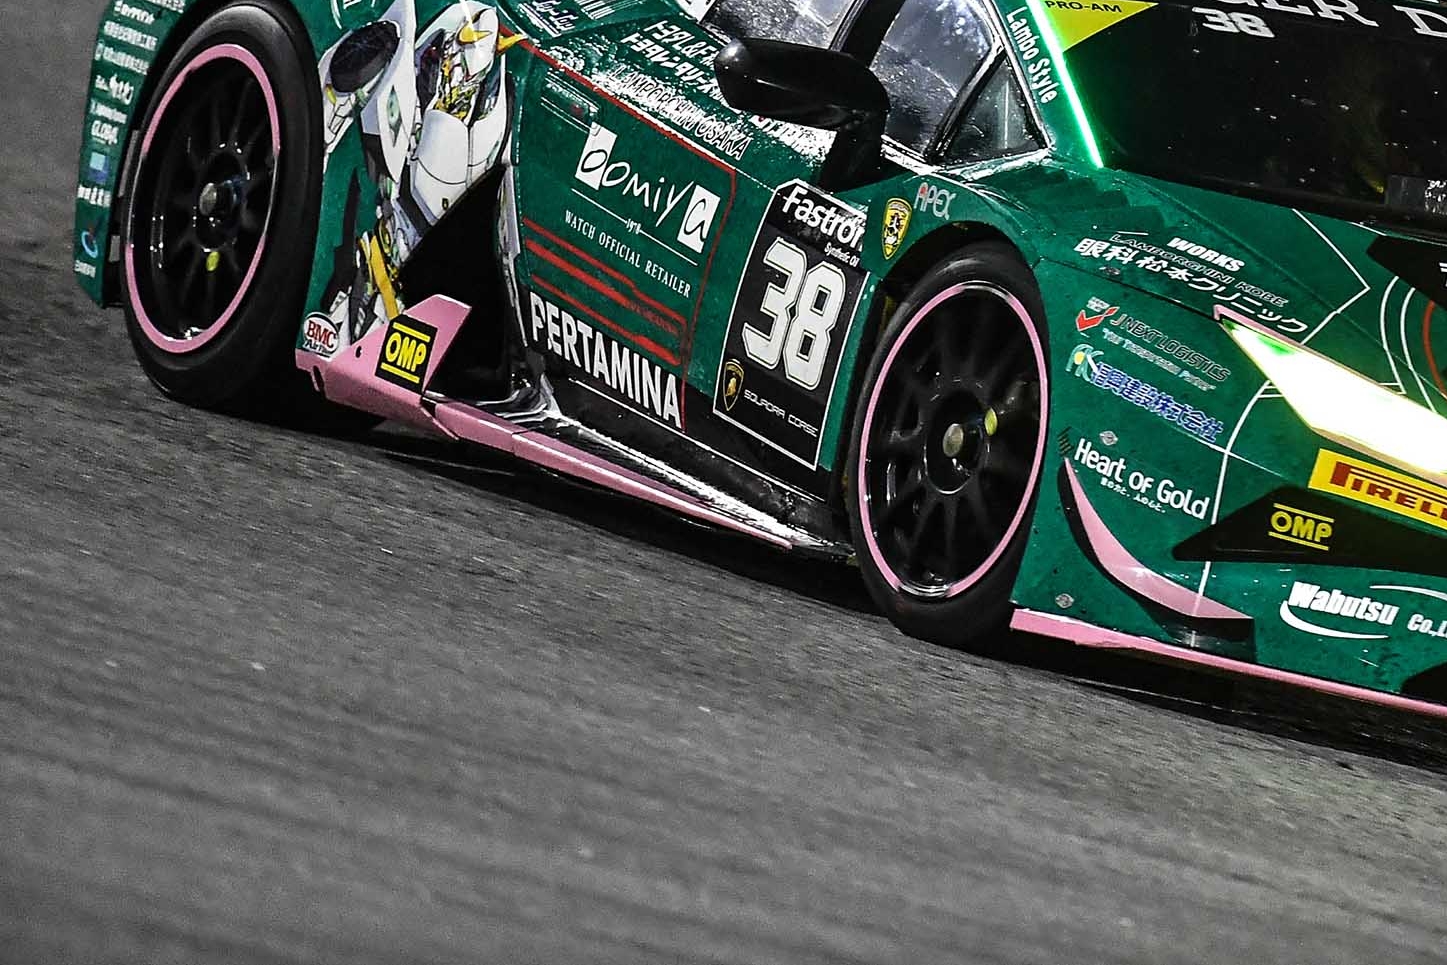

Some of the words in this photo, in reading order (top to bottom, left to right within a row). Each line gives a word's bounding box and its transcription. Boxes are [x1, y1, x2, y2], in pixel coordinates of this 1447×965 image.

[1045, 0, 1122, 14] PRO-AM
[1191, 6, 1276, 39] 38
[1006, 6, 1040, 61] Lambo
[1028, 57, 1061, 105] Style
[564, 209, 597, 240] WATCH
[598, 231, 642, 269] OFFICIAL
[644, 260, 692, 299] RETAILER
[1109, 233, 1236, 285] LAMBORGHINI
[1234, 281, 1290, 308] KOBE
[1166, 237, 1246, 273] WORKS
[1073, 237, 1309, 334] 眼科松本クリニック
[306, 319, 338, 349] BMC
[741, 236, 847, 391] 38
[385, 331, 427, 373] OMP
[529, 291, 683, 429] PERTAMINA
[1155, 336, 1232, 382] LOGISTICS
[743, 388, 785, 420] SQUADRA
[787, 412, 819, 438] CORSE
[1073, 437, 1127, 484] Heart
[1156, 478, 1211, 520] Gold
[1270, 510, 1334, 544] OMP
[1287, 580, 1401, 626] Wabutsu
